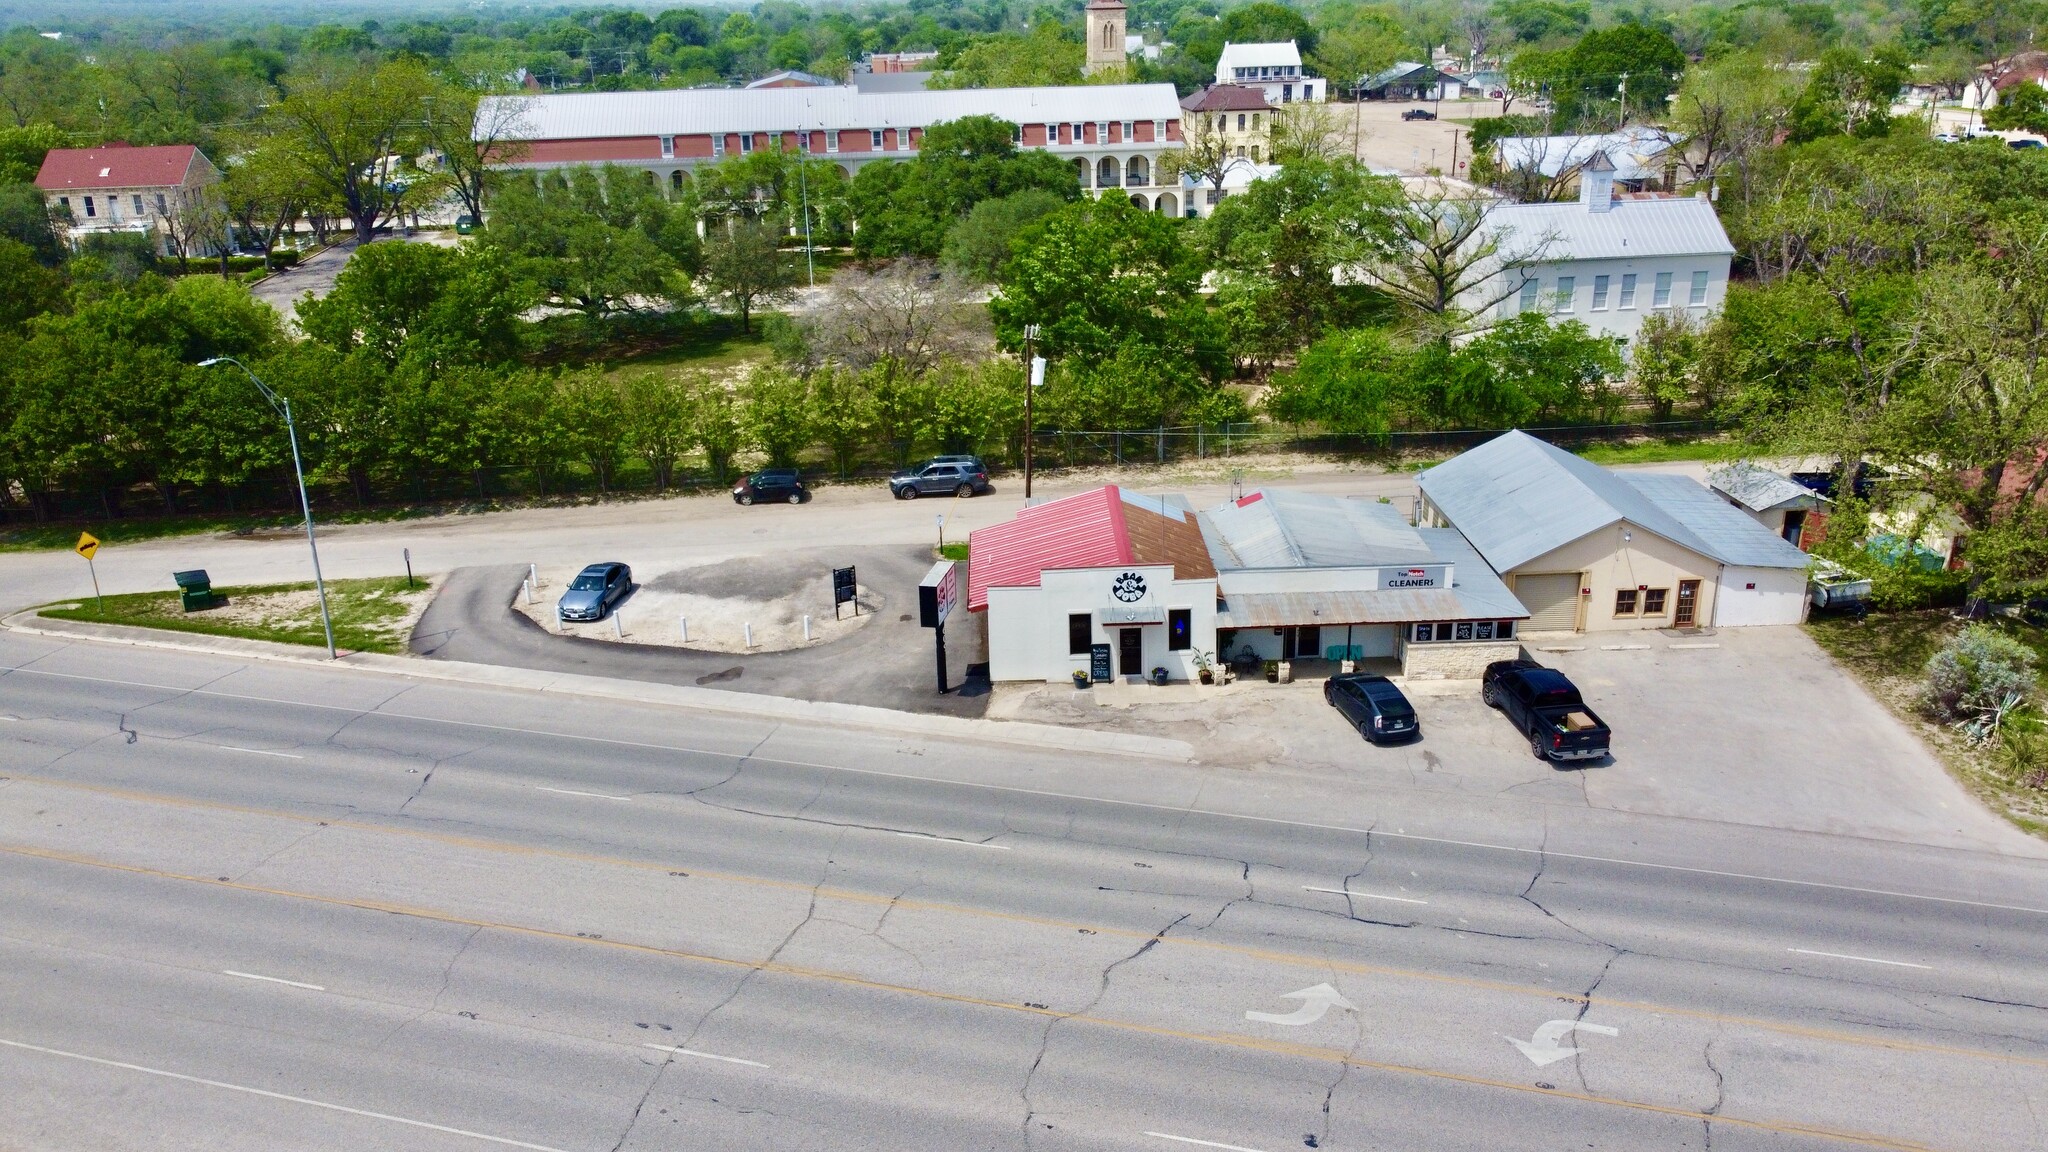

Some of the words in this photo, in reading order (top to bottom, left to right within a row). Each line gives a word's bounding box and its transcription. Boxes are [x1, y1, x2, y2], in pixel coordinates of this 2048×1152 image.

[1115, 572, 1144, 584] BEAN
[1388, 579, 1434, 587] CLEANERS
[1126, 580, 1136, 590] &
[1115, 588, 1144, 601] BOBA
[1327, 645, 1362, 660] OPEN
